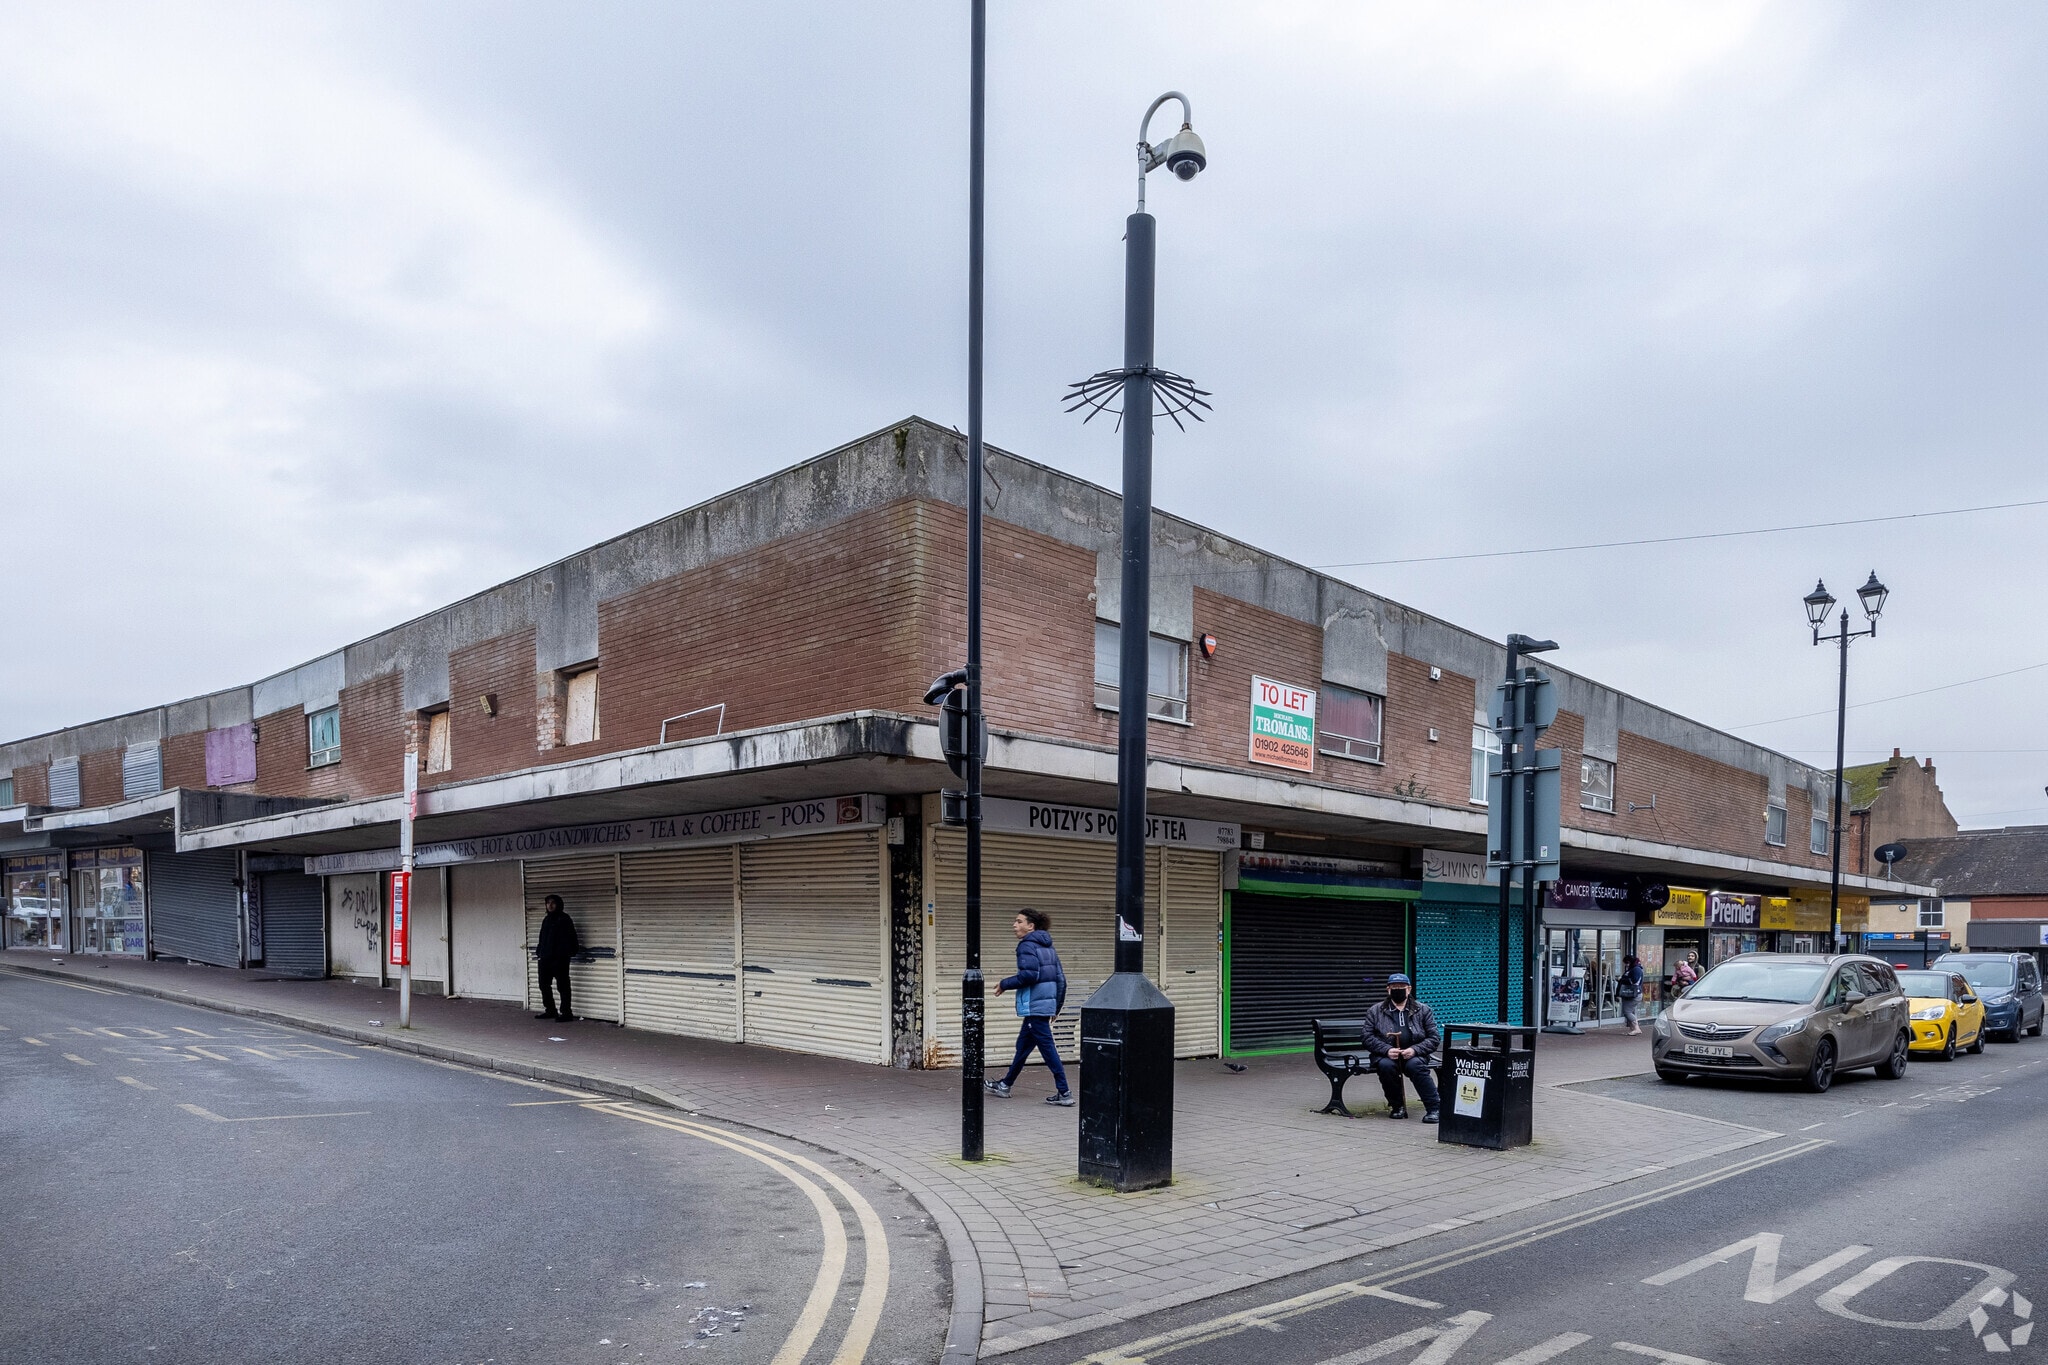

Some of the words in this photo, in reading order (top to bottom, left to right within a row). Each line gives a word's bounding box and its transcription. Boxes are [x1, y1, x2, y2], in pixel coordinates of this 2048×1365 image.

[1260, 682, 1279, 705] TO
[1283, 689, 1309, 711] LET
[1255, 715, 1308, 741] TROMANS
[1254, 737, 1279, 752] 01902
[1280, 743, 1309, 759] 425646
[1029, 805, 1094, 833] POTZY'S
[1098, 813, 1117, 836] PO
[1162, 819, 1188, 842] TEA
[1217, 826, 1234, 836] 07783
[318, 855, 331, 870] ALL
[332, 855, 346, 869] DAY
[481, 837, 504, 855] HOT
[505, 840, 513, 852] &
[516, 833, 546, 851] COLD
[549, 823, 632, 848] SANDWICHES
[650, 819, 677, 839] TEA
[682, 818, 694, 836] &
[700, 810, 761, 835] COFFEE
[781, 802, 826, 827] POPS
[1441, 860, 1478, 880] LIVING
[1564, 884, 1590, 898] CANCER
[1590, 885, 1619, 899] RESEARCH
[1619, 888, 1629, 900] UK
[1677, 894, 1692, 904] MART
[1657, 909, 1689, 921] Convenience
[1689, 910, 1702, 921] Store
[1711, 896, 1756, 924] Premier
[103, 1043, 360, 1062] BUS
[1688, 1045, 1710, 1055] SW64
[1711, 1047, 1729, 1056] JYL
[1455, 1056, 1493, 1071] Walsall
[1511, 1059, 1531, 1071] Walsall
[1454, 1067, 1492, 1080] COUNCIL
[1510, 1070, 1530, 1080] COUNCIL
[1640, 1232, 2019, 1332] NO
